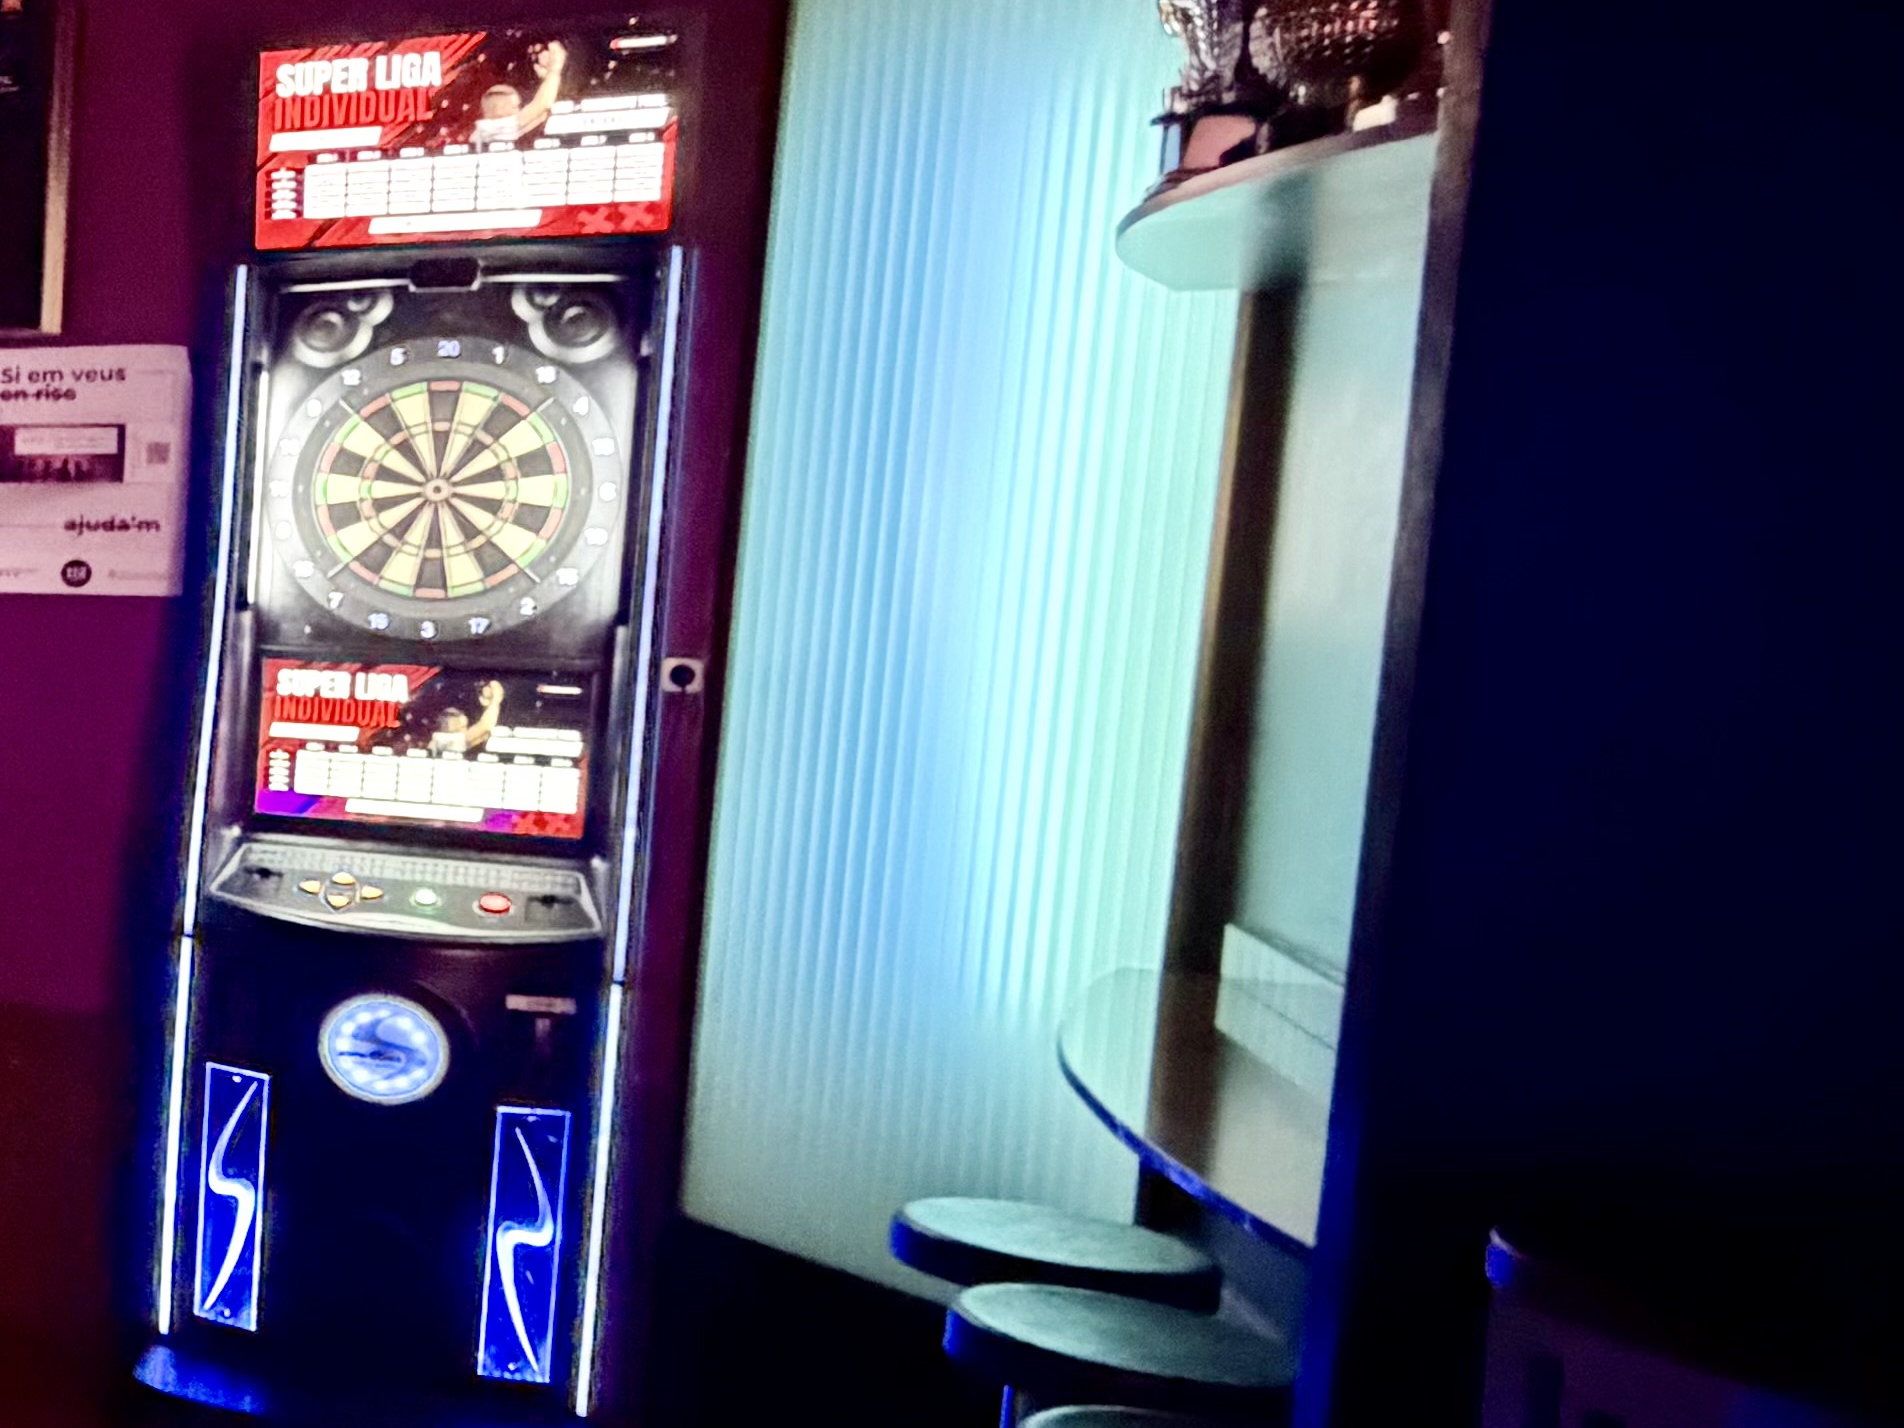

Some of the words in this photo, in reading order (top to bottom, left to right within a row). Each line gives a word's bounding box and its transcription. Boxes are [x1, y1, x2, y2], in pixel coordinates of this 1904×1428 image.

[275, 57, 369, 98] SUPER
[374, 50, 442, 91] LIGA
[273, 85, 434, 131] INDIVIDUAL
[437, 339, 461, 358] 20
[0, 366, 21, 384] Si
[28, 369, 64, 383] em
[71, 367, 126, 382] veus
[0, 389, 29, 402] en
[63, 514, 161, 536] ajuda'm
[276, 667, 352, 700] SUPER
[354, 672, 410, 703] LIGA
[274, 696, 402, 728] INDIVIDUAL
